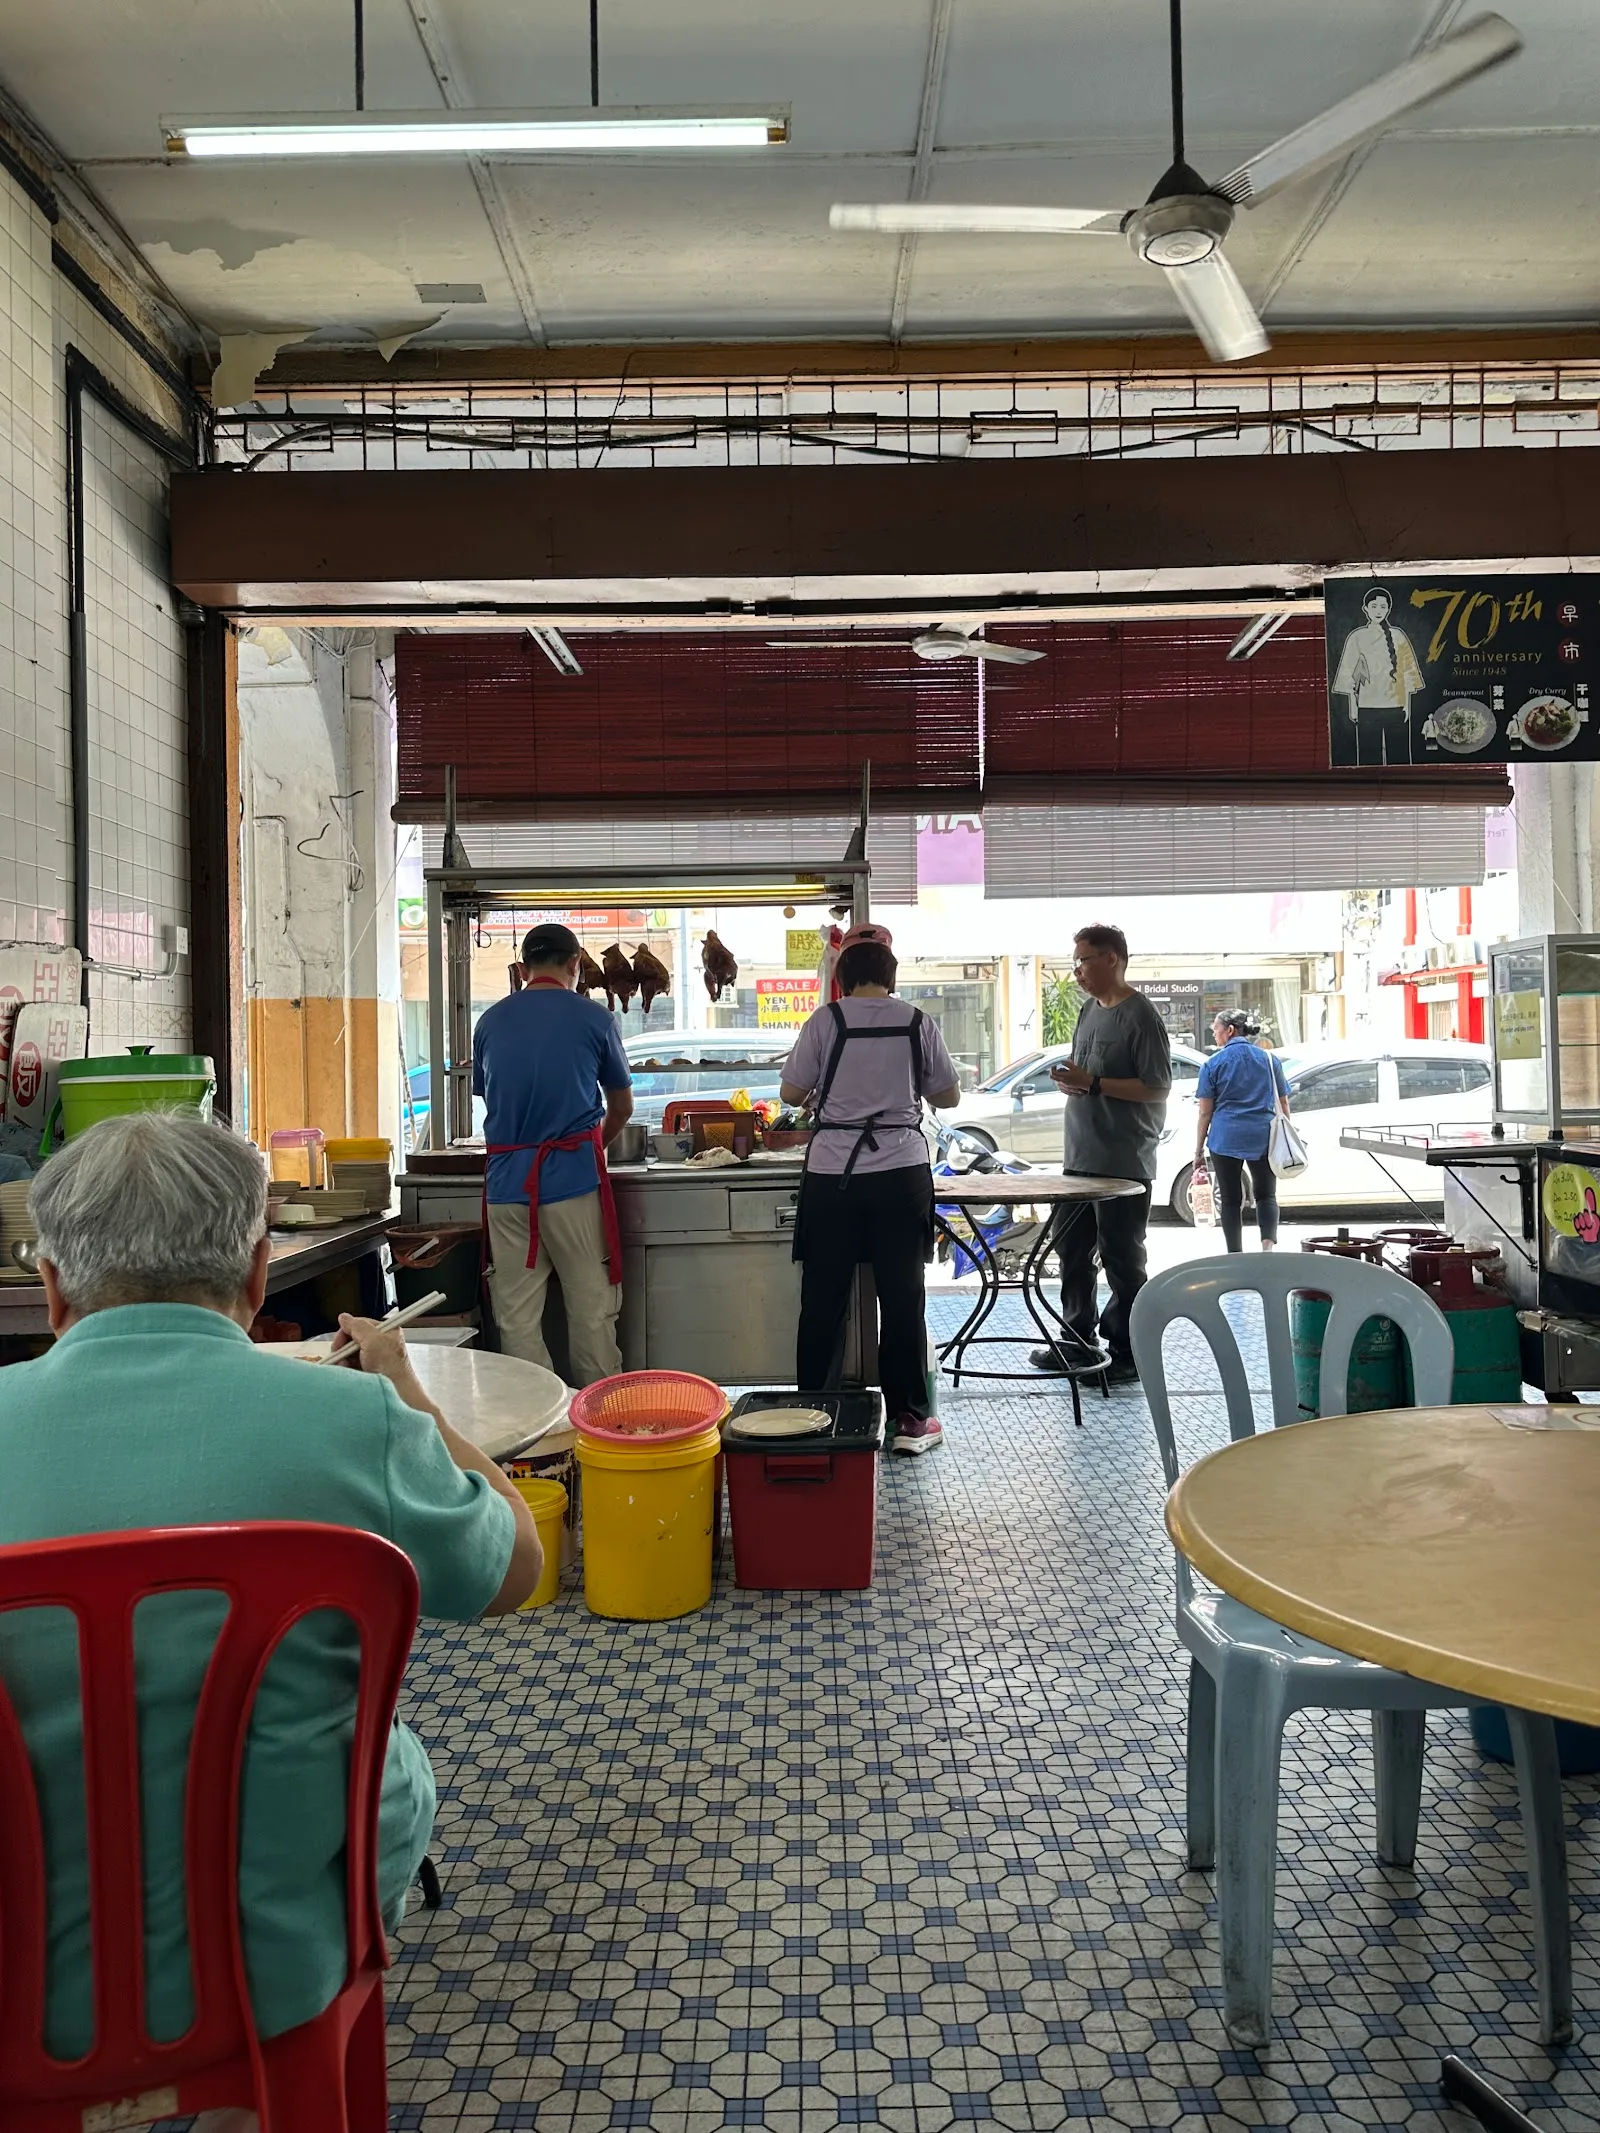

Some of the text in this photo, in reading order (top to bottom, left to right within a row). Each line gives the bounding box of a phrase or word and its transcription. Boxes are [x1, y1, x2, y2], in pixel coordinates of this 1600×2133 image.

[1410, 588, 1543, 664] 70th
[1453, 651, 1542, 663] anniversary
[1453, 667, 1479, 676] Since
[1442, 688, 1485, 697] Beansprout
[1528, 686, 1567, 696] Dry Curry
[776, 981, 811, 991] SALE
[1144, 984, 1168, 993] Bridal
[1171, 984, 1199, 993] Studio
[762, 1021, 791, 1030] SHAN
